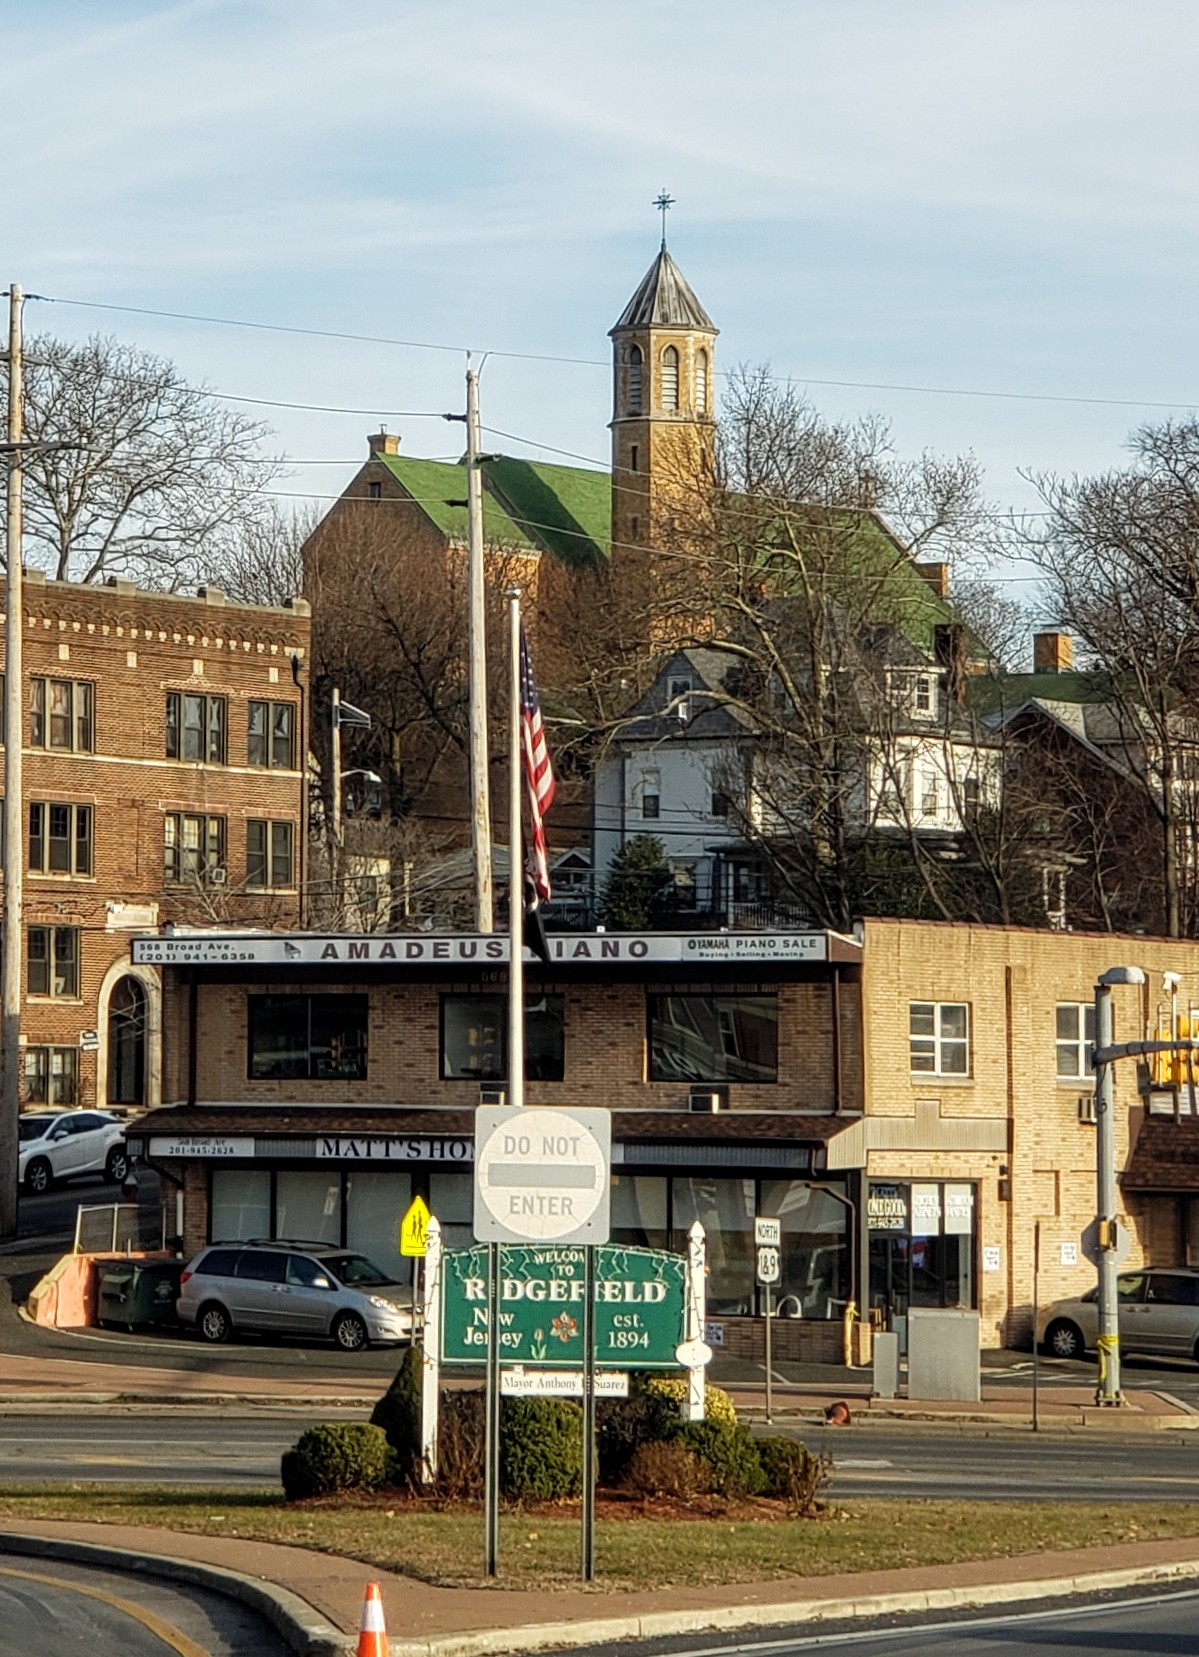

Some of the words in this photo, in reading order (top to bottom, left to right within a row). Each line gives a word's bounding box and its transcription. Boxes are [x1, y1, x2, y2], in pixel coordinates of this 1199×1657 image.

[320, 941, 503, 960] AMADEUS
[531, 940, 648, 958] IANO
[736, 940, 776, 948] PIANO
[783, 939, 817, 948] SALE
[504, 1135, 531, 1156] DO
[542, 1135, 580, 1157] NOT
[509, 1195, 574, 1216] ENTER
[757, 1223, 778, 1239] NORTH
[533, 1250, 585, 1264] WELCO
[556, 1265, 575, 1276] TO
[473, 1307, 515, 1326] Nw
[613, 1313, 644, 1328] est.
[463, 1326, 523, 1349] Jeey
[608, 1331, 650, 1349] 1894
[504, 1377, 533, 1390] Mayor
[537, 1377, 577, 1391] Anthony
